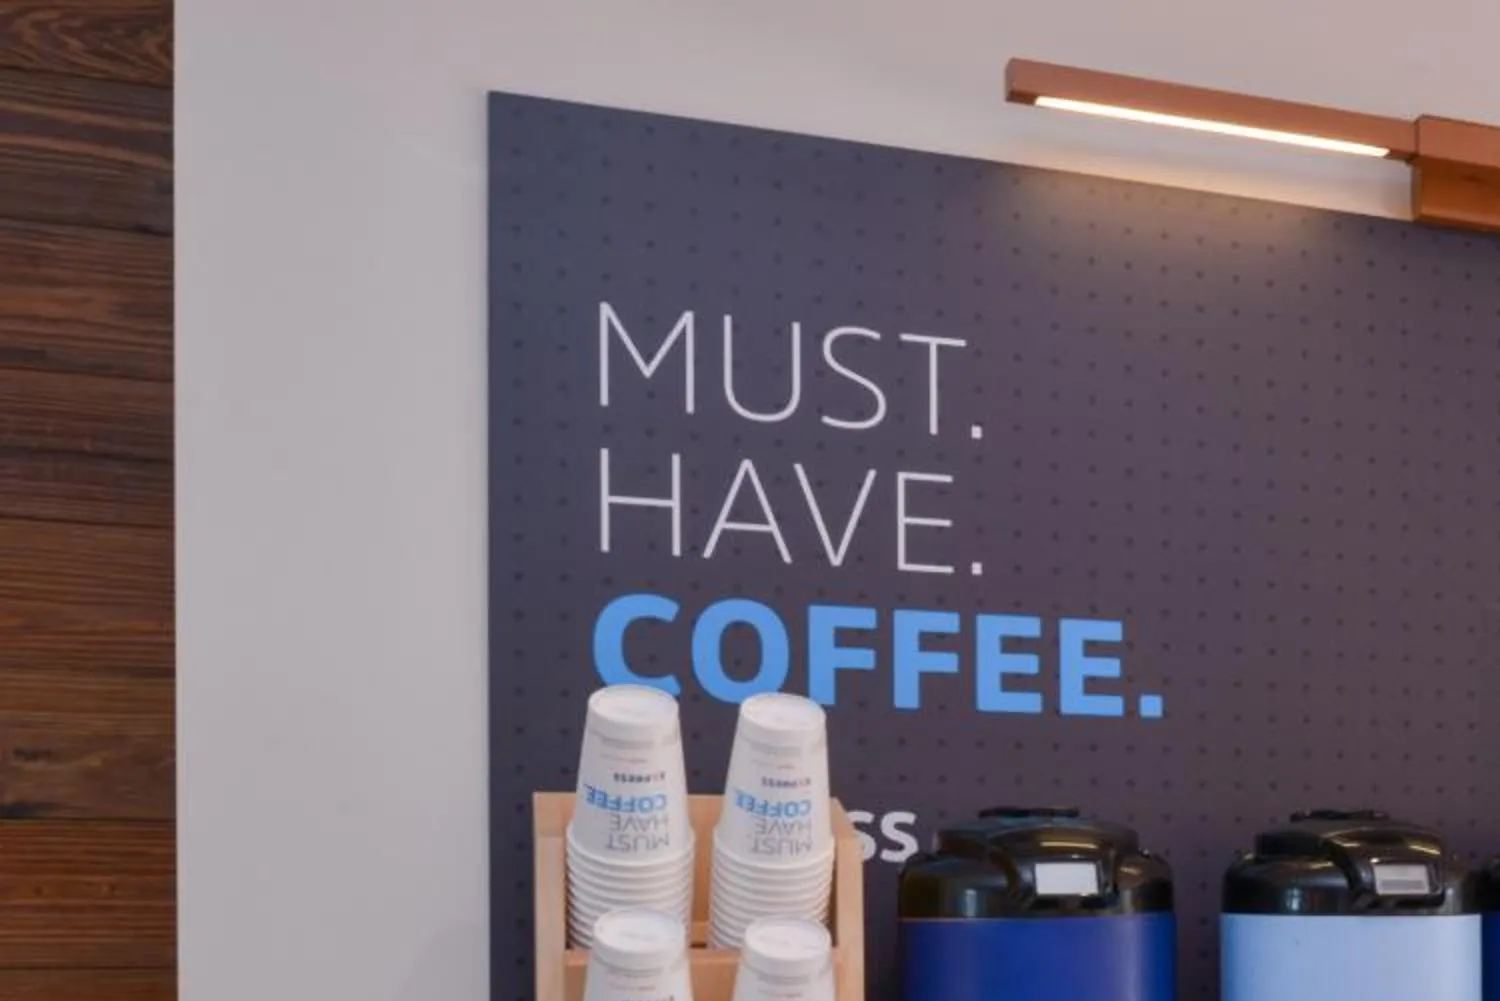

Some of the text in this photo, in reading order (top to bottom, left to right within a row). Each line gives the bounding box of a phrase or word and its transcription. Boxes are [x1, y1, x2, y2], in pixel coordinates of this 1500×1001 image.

[600, 301, 983, 439] MUST.
[600, 447, 983, 575] HAVE.
[592, 592, 1163, 718] COFFEE.
